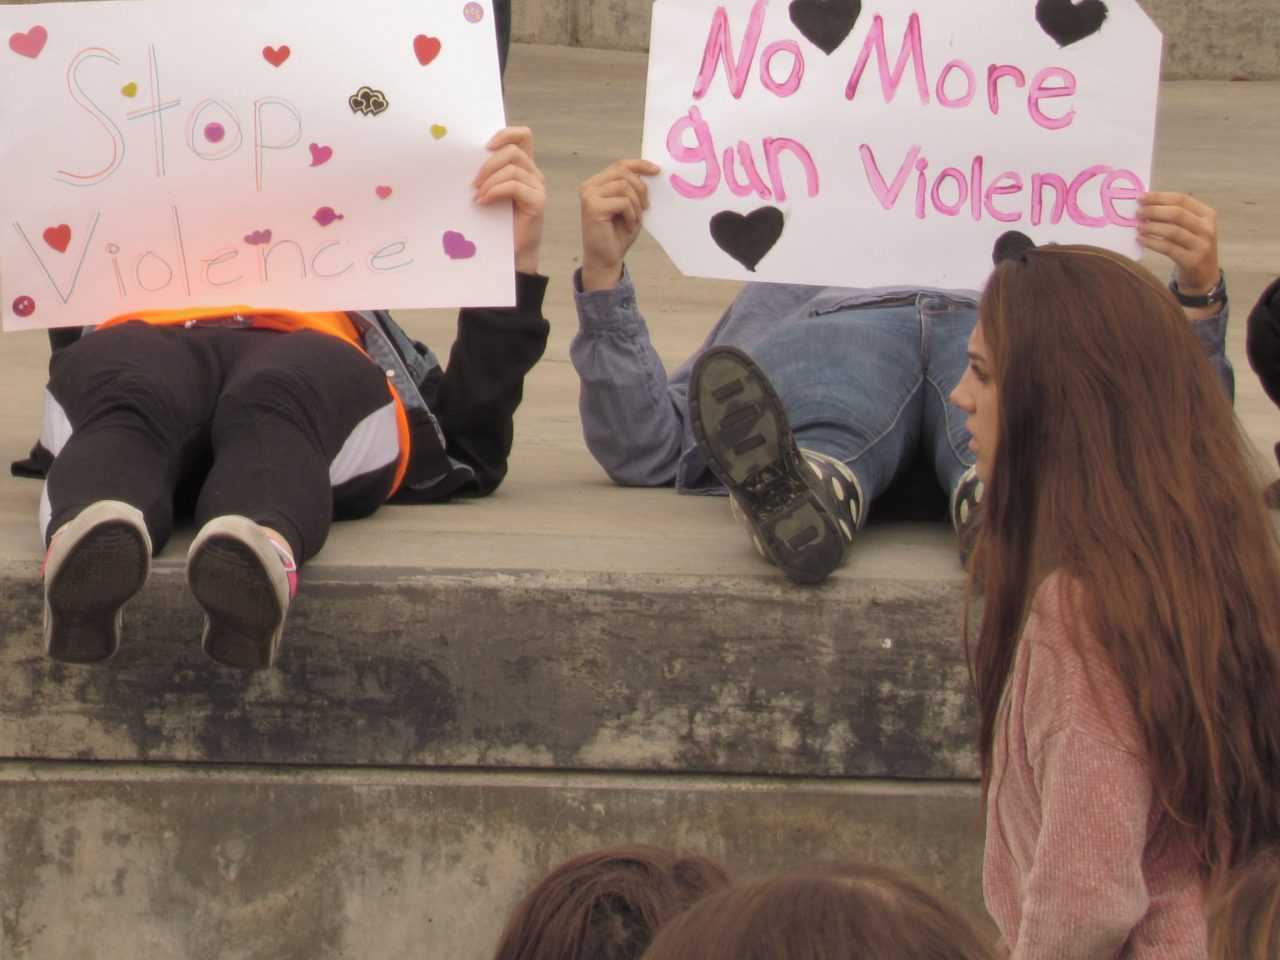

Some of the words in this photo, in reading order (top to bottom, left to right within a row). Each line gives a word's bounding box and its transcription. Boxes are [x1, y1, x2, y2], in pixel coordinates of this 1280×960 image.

[53, 43, 302, 192] Stop
[845, 11, 1077, 129] More
[666, 106, 819, 202] gun
[13, 205, 414, 305] Violence
